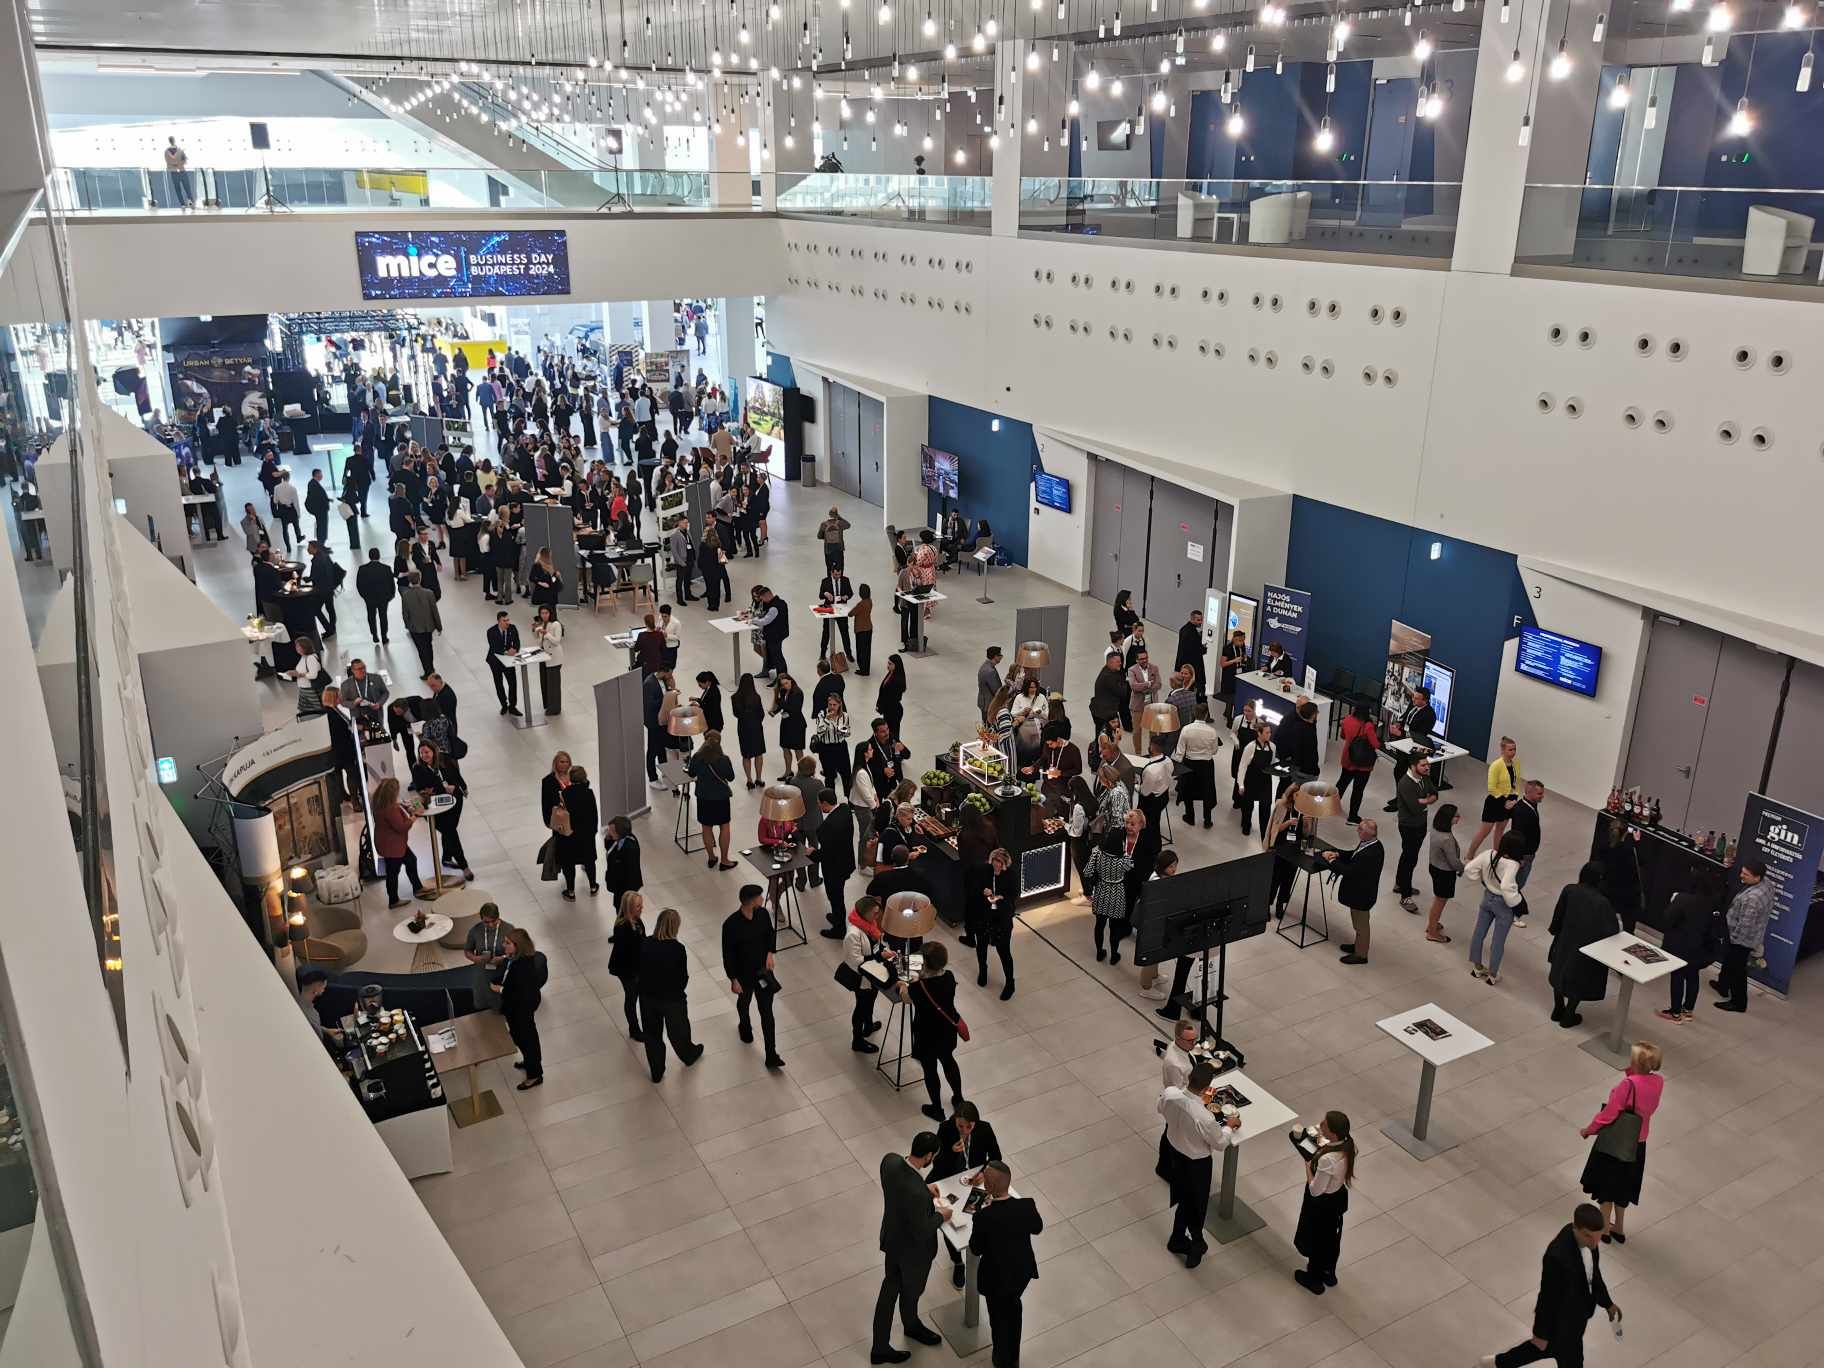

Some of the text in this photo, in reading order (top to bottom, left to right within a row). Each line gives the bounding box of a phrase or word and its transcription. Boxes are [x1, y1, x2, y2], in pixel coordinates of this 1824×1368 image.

[375, 245, 457, 278] mice
[470, 253, 554, 264] BUSINESS DAY
[471, 264, 555, 275] BUDAPEST 2024
[1267, 591, 1291, 602] HAJÓS
[1533, 586, 1542, 599] 3
